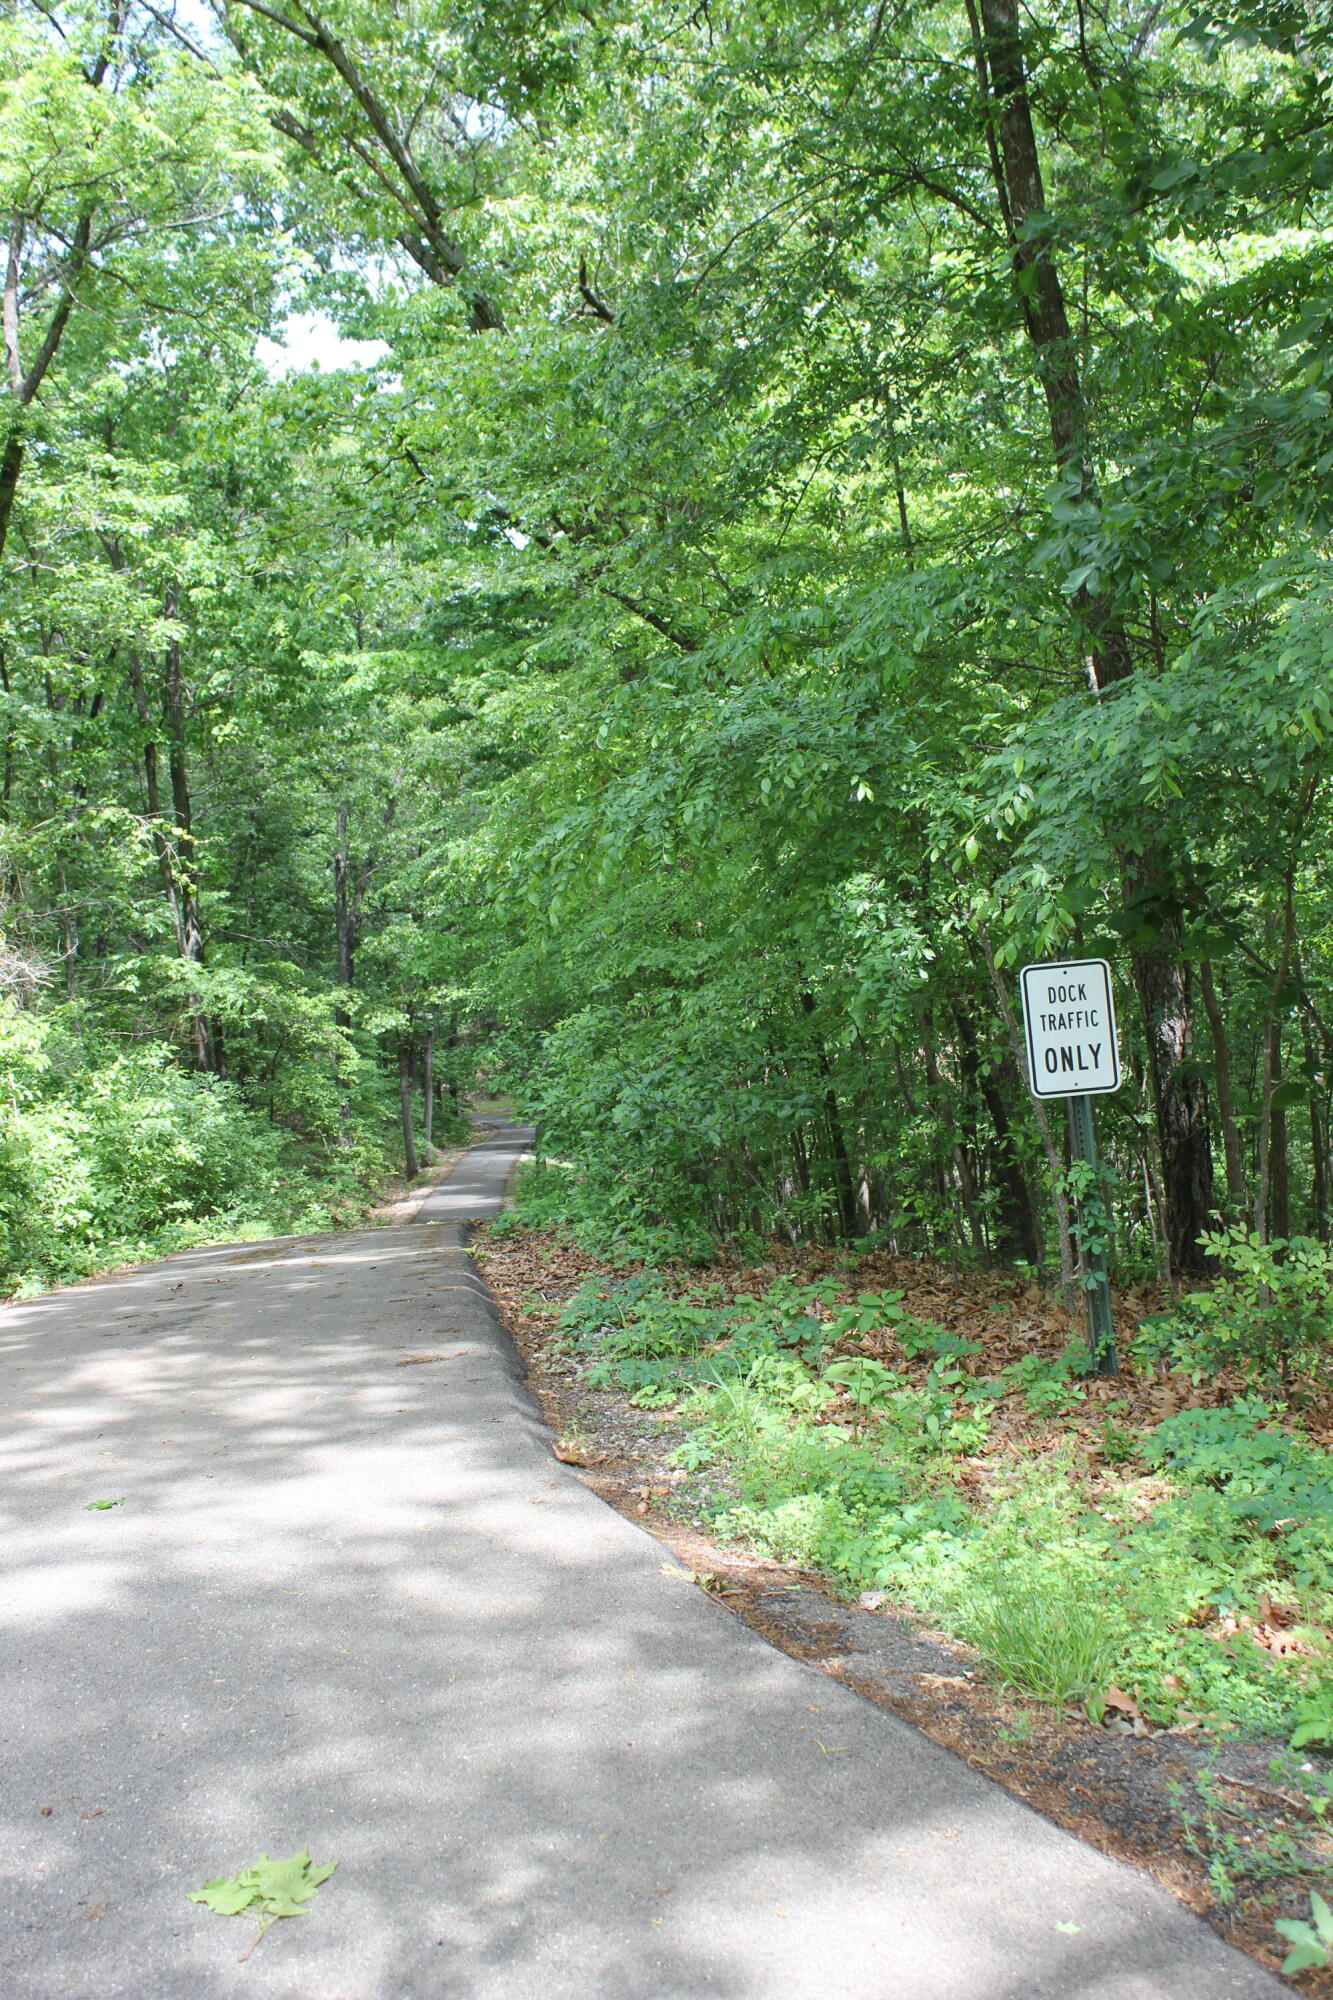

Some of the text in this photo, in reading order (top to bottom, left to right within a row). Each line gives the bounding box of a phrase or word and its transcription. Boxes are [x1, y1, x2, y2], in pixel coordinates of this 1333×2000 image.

[1048, 984, 1087, 1004] DOCK
[1040, 1010, 1099, 1032] TRAFFIC
[1045, 1043, 1101, 1073] ONLY
